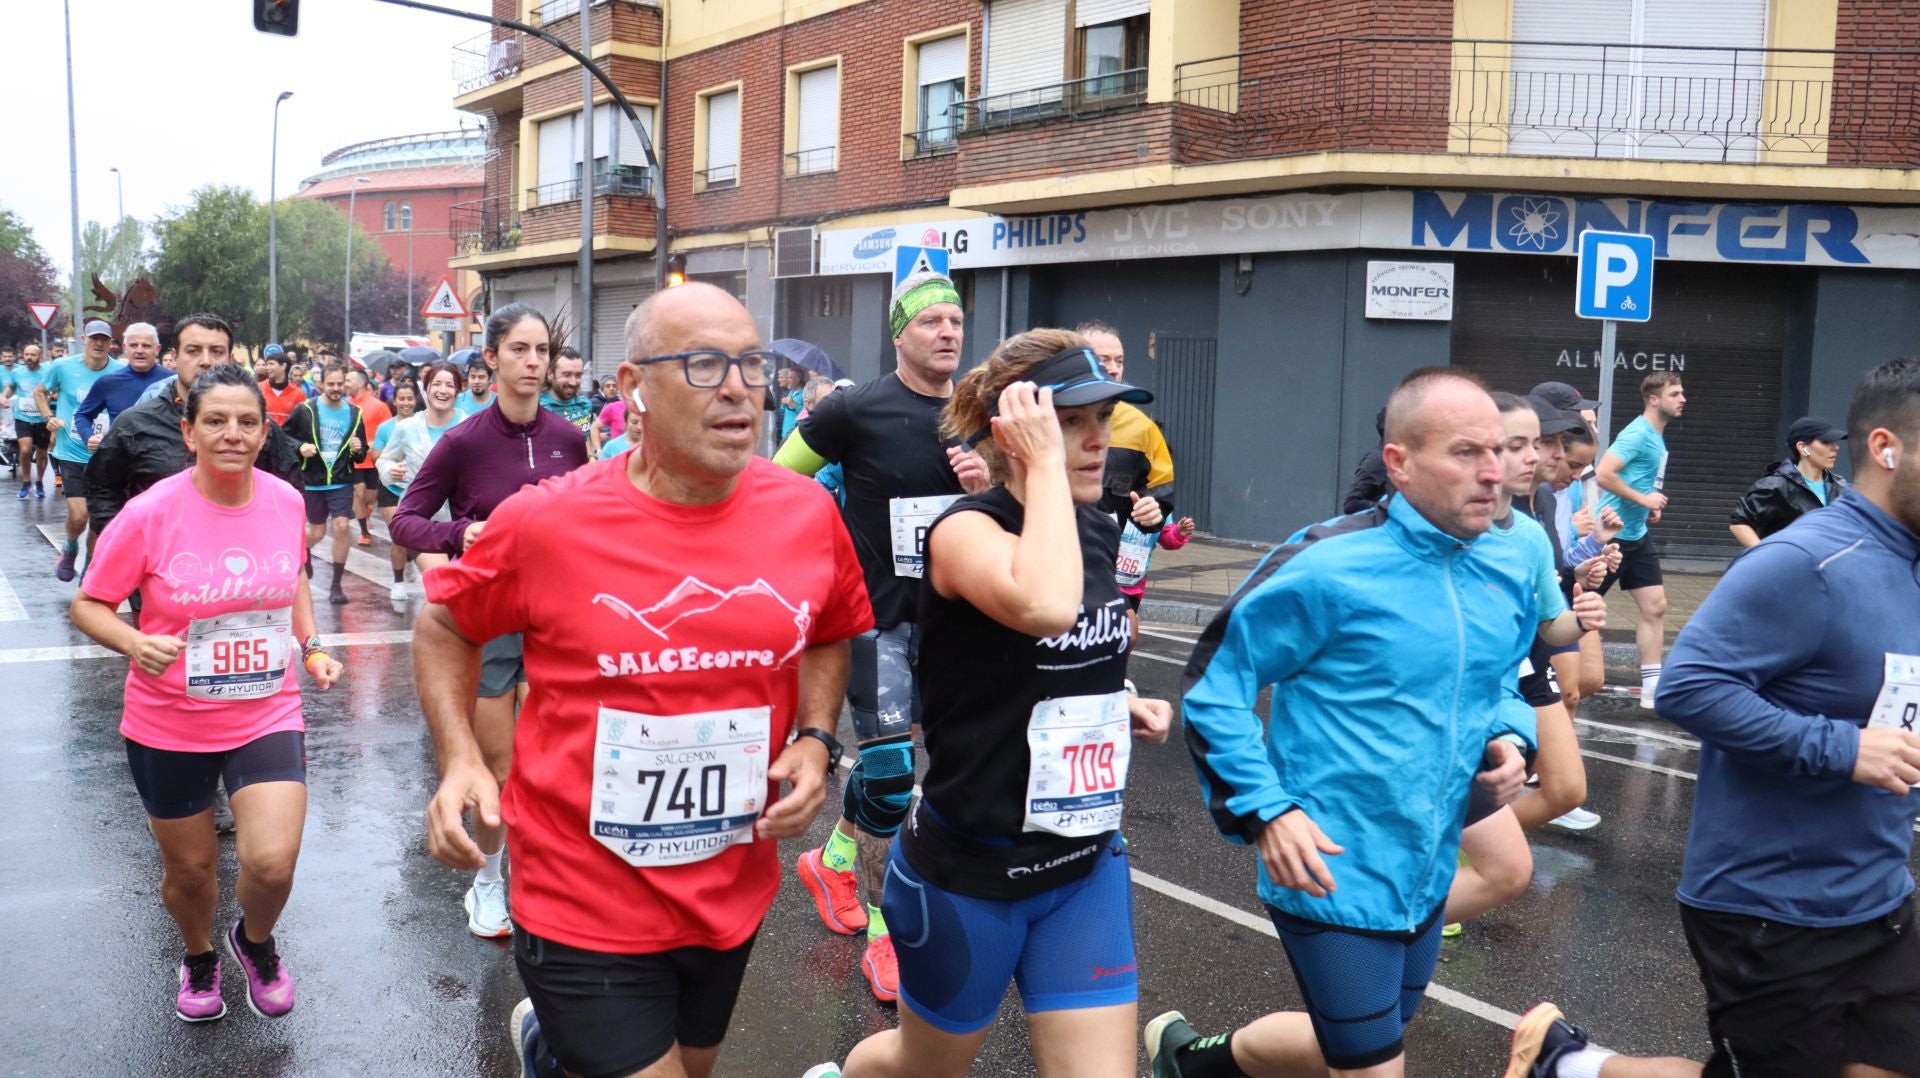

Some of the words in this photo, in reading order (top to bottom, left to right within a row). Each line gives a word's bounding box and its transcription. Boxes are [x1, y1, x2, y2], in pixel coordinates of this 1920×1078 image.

[992, 212, 1087, 250] PHILIPS
[1113, 206, 1189, 241] JVC
[1221, 201, 1344, 232] SONY
[1411, 191, 1871, 263] MONFER
[822, 260, 887, 273] SERVICIO
[1110, 243, 1198, 259] TECNICA
[858, 237, 896, 251] SAMSUN
[941, 229, 968, 255] LG
[1593, 242, 1639, 308] P
[1371, 285, 1450, 298] MONFER
[213, 638, 268, 674] 965
[597, 646, 775, 678] SALCEcorre
[228, 682, 274, 694] HYUNDAI
[1062, 742, 1116, 795] 709
[637, 764, 727, 822] 740
[659, 834, 734, 855] HYUNDAI
